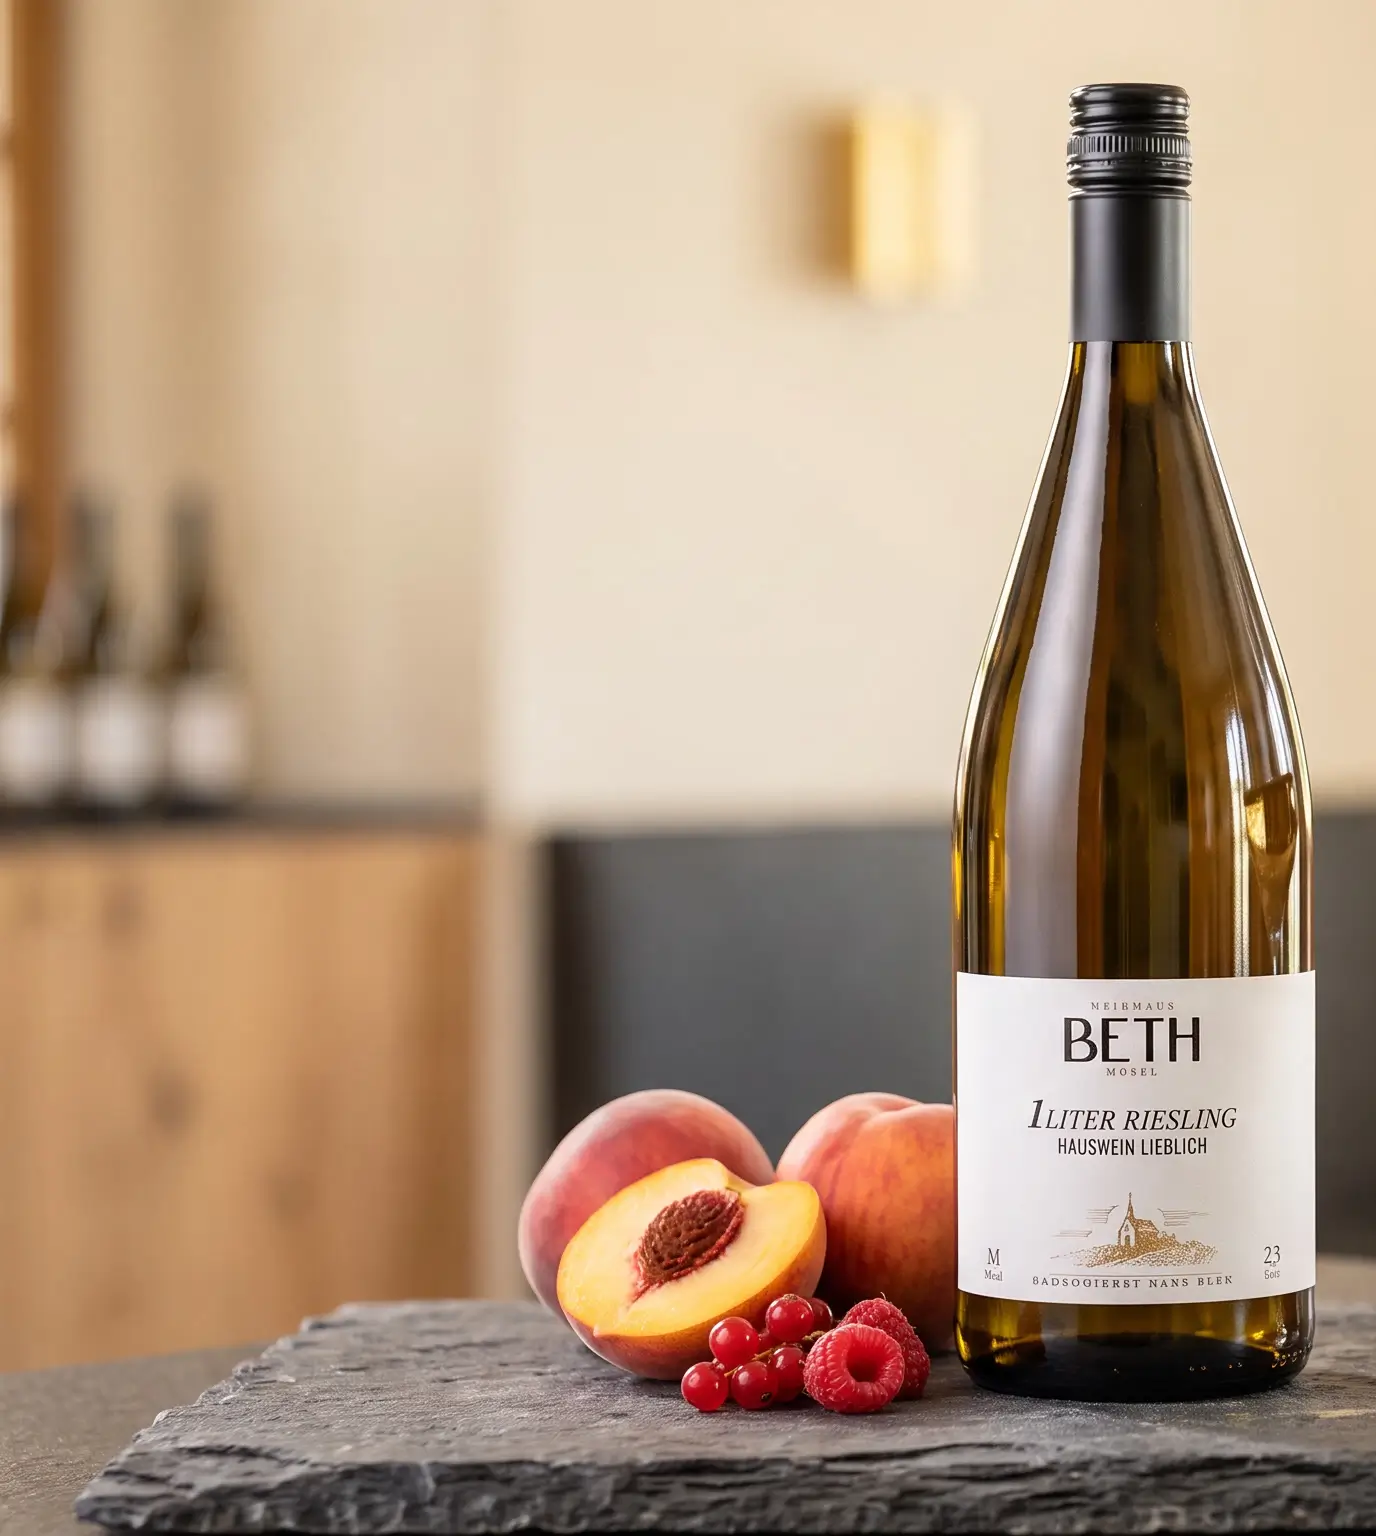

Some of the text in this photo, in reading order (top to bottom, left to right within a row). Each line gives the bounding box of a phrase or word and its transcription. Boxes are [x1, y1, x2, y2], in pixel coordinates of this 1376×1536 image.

[1064, 1017, 1200, 1062] BETH
[1106, 1067, 1158, 1076] MOSEL
[1122, 1107, 1237, 1130] RIESLING
[1058, 1137, 1207, 1155] HAUSWEIN LIEBLICH
[987, 1247, 1000, 1266] M
[1264, 1245, 1280, 1264] 23
[1149, 1278, 1189, 1288] NANS
